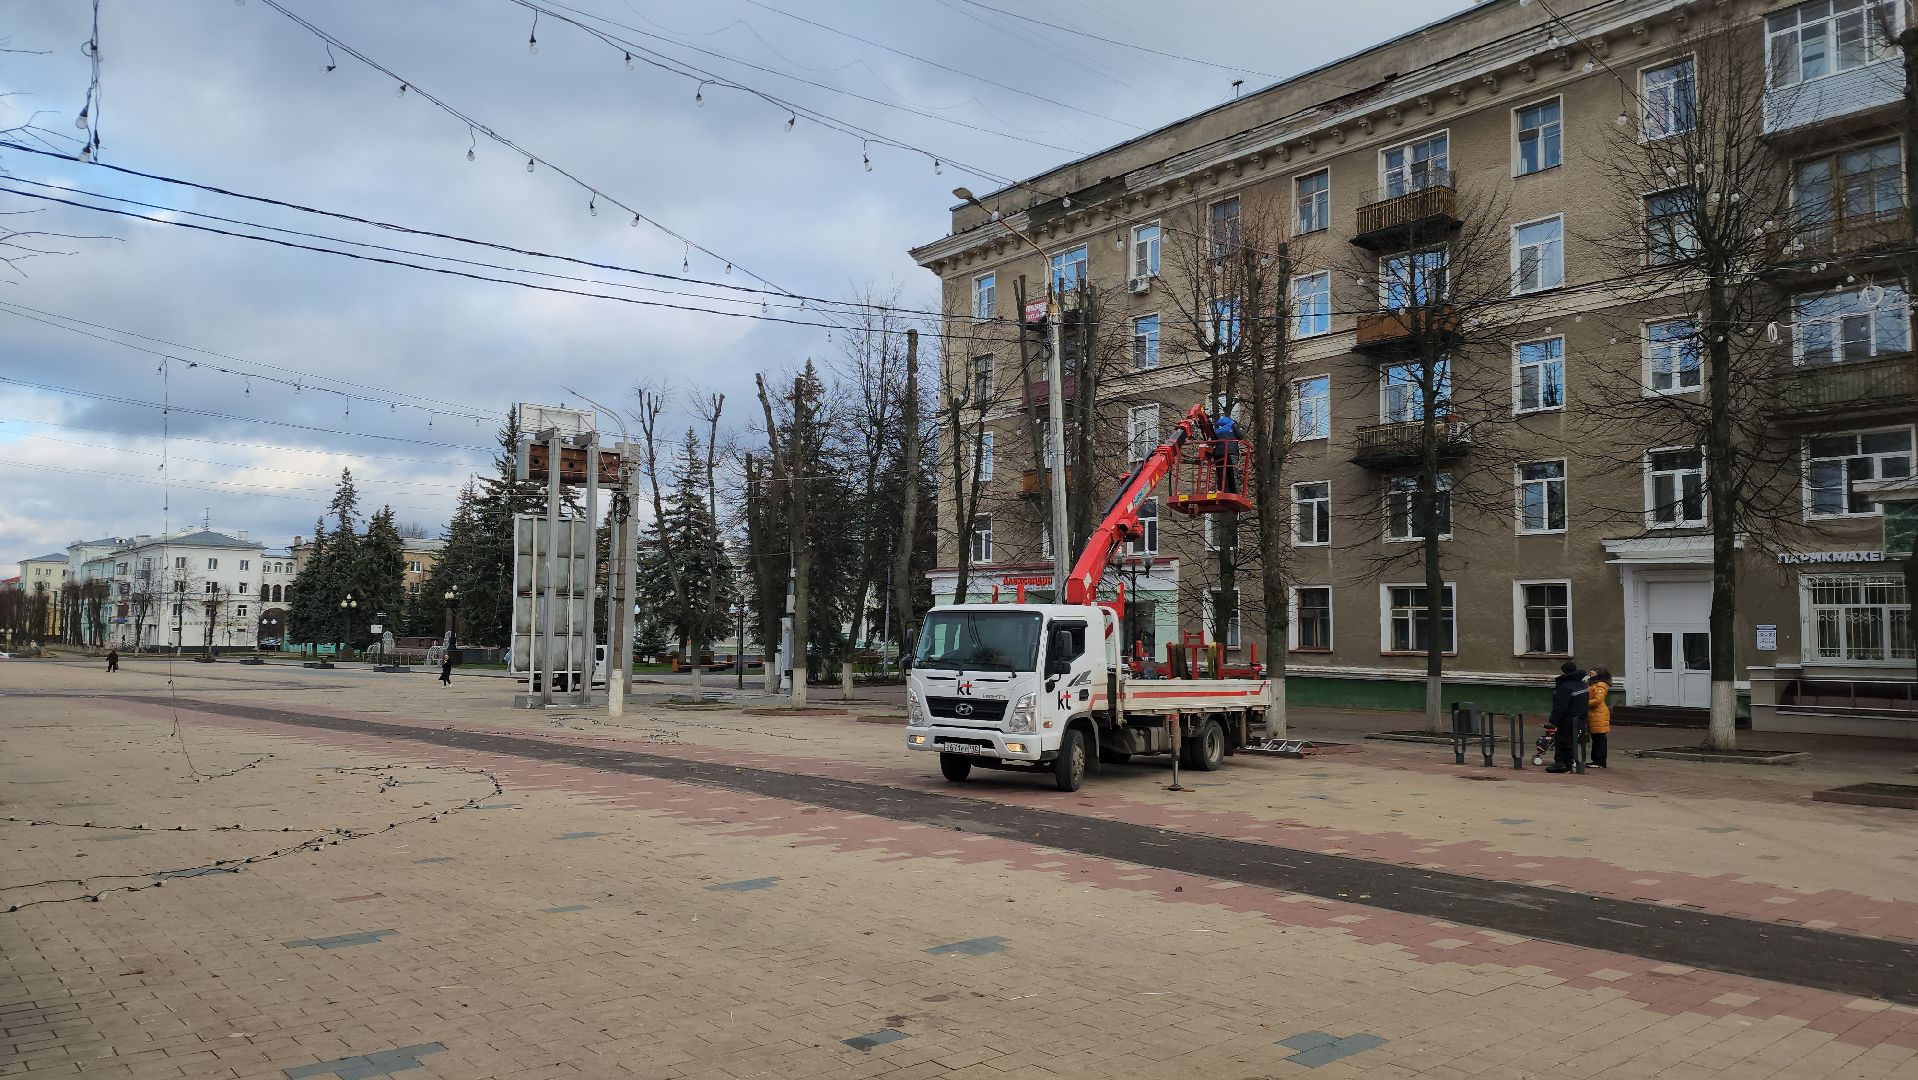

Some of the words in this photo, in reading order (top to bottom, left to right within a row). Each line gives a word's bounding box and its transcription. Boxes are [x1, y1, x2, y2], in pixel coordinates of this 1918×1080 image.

[1777, 551, 1884, 564] ПАРИКМАХЕ
[956, 680, 972, 695] kt
[1057, 690, 1071, 710] kt
